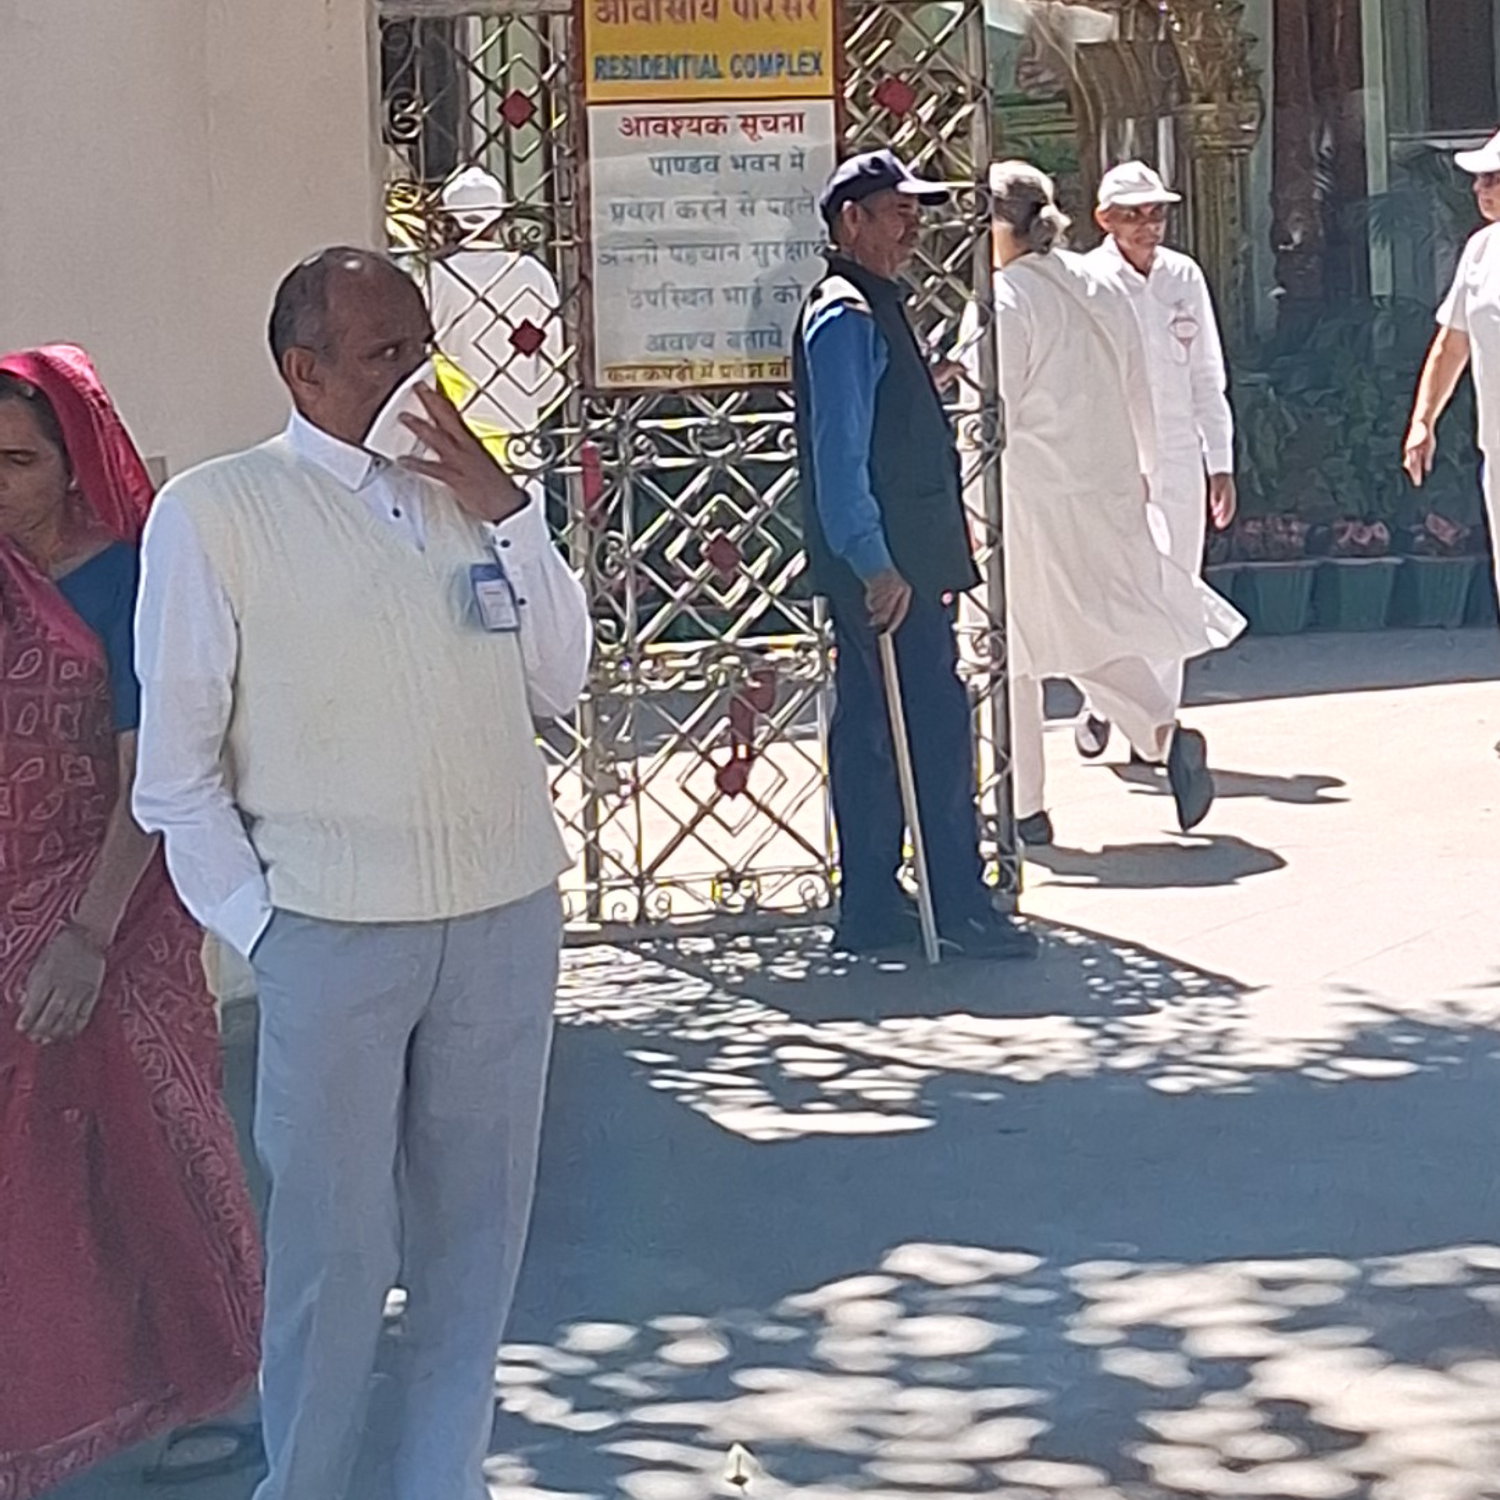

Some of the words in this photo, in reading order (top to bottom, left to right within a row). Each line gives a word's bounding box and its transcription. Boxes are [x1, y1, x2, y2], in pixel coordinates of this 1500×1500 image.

[593, 51, 724, 82] RESIDENTIAL
[729, 48, 824, 81] COMPLEX
[618, 114, 729, 140] आवश्यक
[738, 111, 806, 143] सूचना
[649, 153, 721, 177] पाण्डव
[731, 152, 781, 174] भवन
